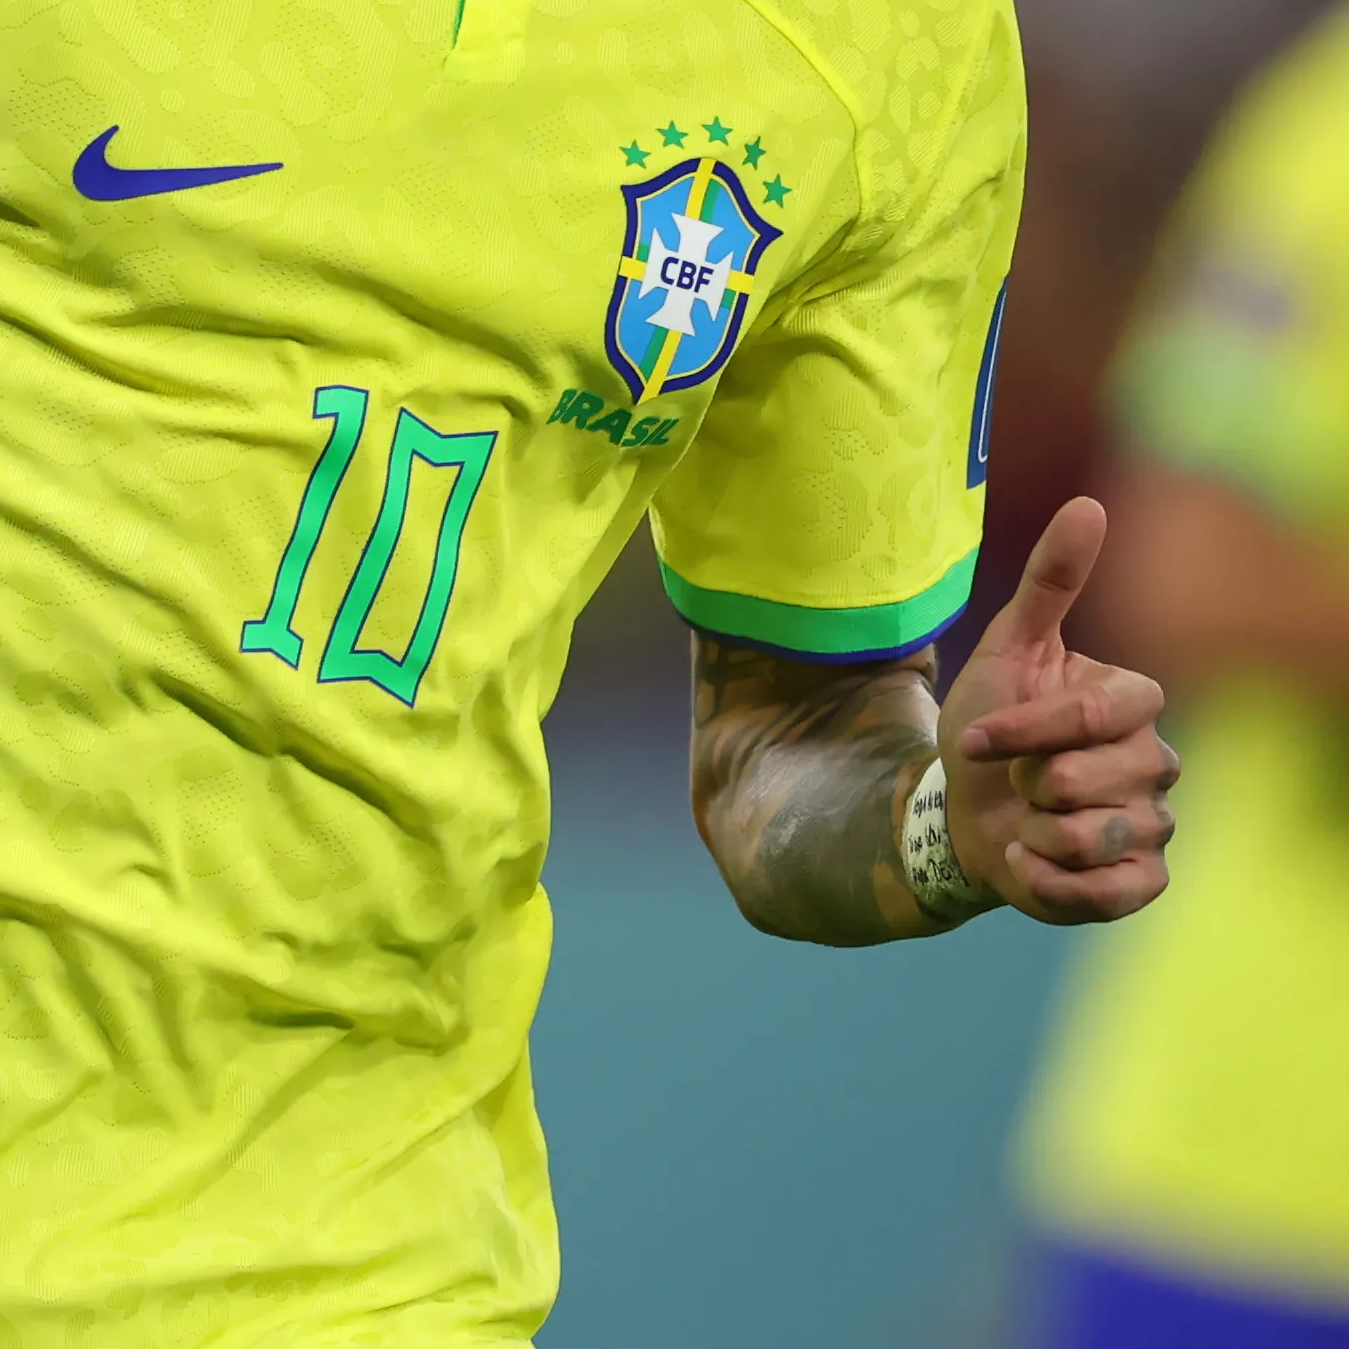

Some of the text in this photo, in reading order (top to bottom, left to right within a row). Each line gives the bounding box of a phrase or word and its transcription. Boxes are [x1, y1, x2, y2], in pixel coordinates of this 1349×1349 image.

[658, 255, 716, 294] CBF
[545, 387, 680, 448] BRASIL
[239, 383, 500, 710] 10
